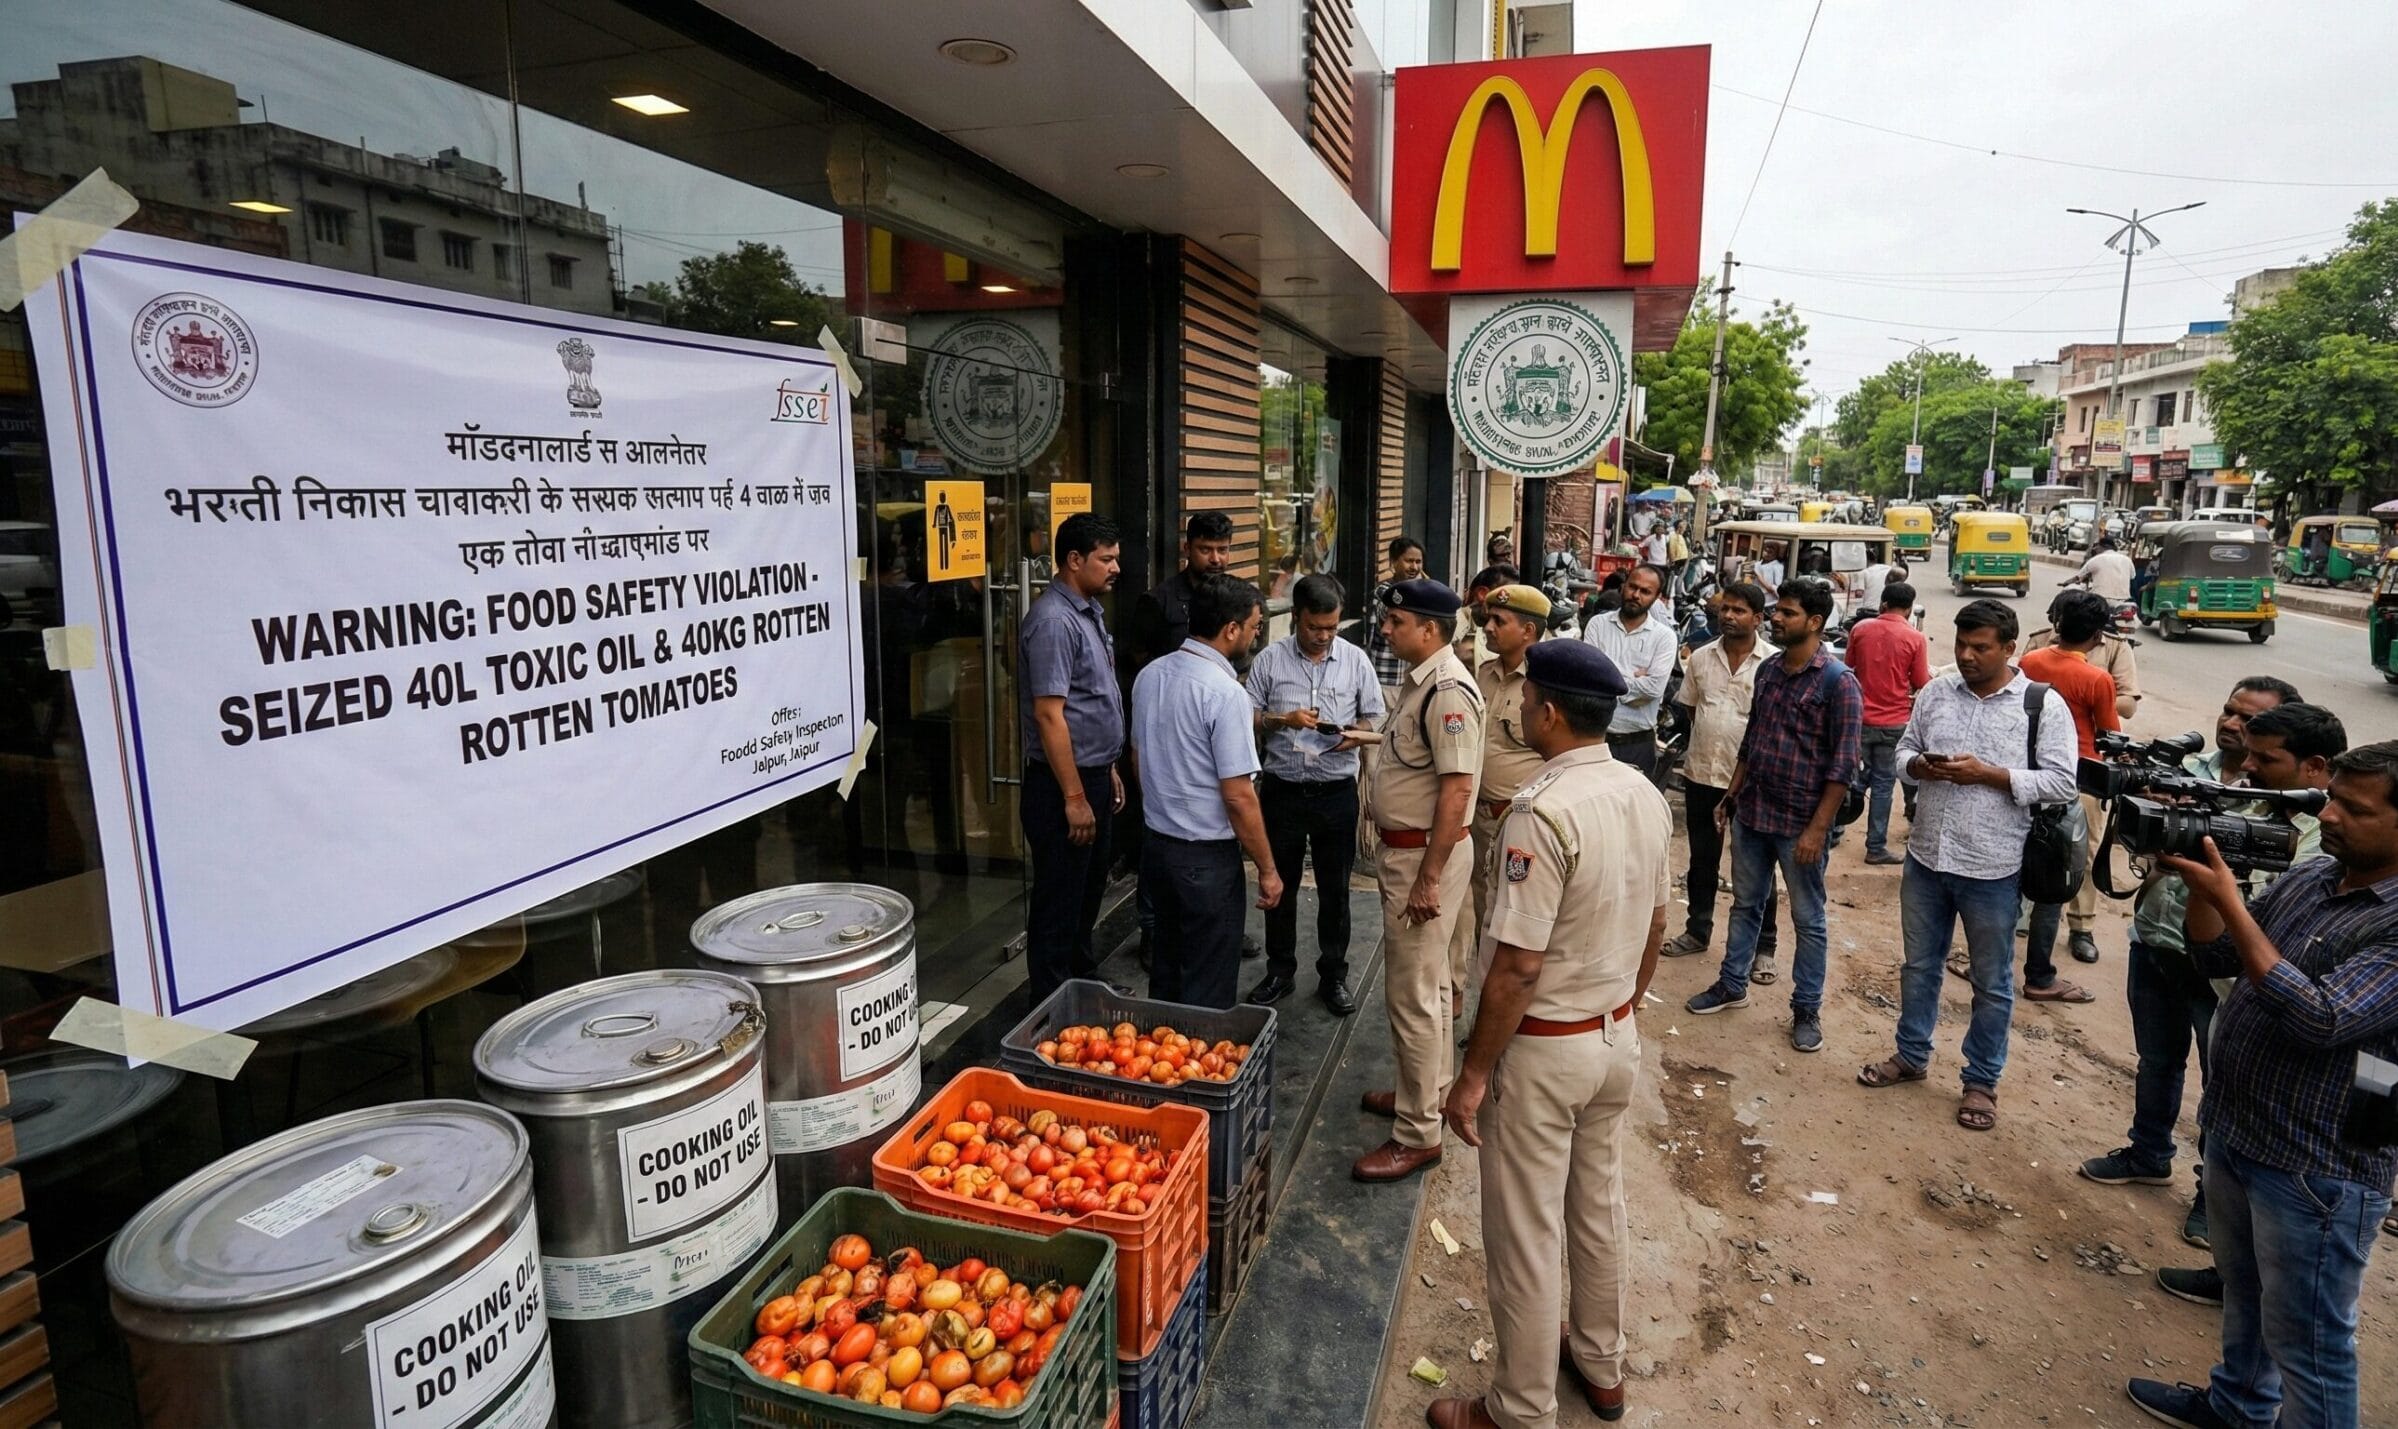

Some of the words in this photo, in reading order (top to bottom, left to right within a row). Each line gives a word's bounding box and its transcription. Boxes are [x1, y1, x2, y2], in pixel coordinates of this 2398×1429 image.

[597, 439, 618, 464] स
[292, 475, 406, 521] निकास
[537, 477, 563, 513] के
[740, 484, 751, 507] 4
[792, 477, 804, 505] में
[458, 540, 504, 575] एक
[513, 529, 565, 566] तोवा
[685, 528, 710, 552] पर
[252, 599, 477, 665] WARNING:
[486, 586, 577, 635] FOOD
[586, 575, 688, 620] SAFETY
[694, 562, 807, 605] VIOLATION
[219, 674, 393, 747] SEIZED
[407, 661, 477, 710] 40L
[486, 643, 588, 695] TOXIC
[597, 634, 645, 675] OIL
[654, 629, 673, 664] &
[682, 615, 746, 657] 40KG
[754, 602, 831, 645] ROTTEN
[460, 698, 594, 765] ROTTEN
[601, 666, 738, 728] TOMATOES
[721, 738, 757, 764] Foodd
[850, 982, 909, 1027] COOKING
[861, 1026, 882, 1050] DO
[886, 1009, 907, 1039] NOT
[638, 1118, 734, 1177] COOKING
[738, 1099, 758, 1131] OIL
[655, 1174, 687, 1205] DO
[694, 1150, 732, 1190] NOT
[737, 1125, 762, 1164] USE
[394, 1280, 511, 1378] COOKING
[515, 1251, 536, 1292] OIL
[416, 1365, 457, 1410] DO
[465, 1321, 509, 1380] NOT
[515, 1283, 539, 1335] USE
